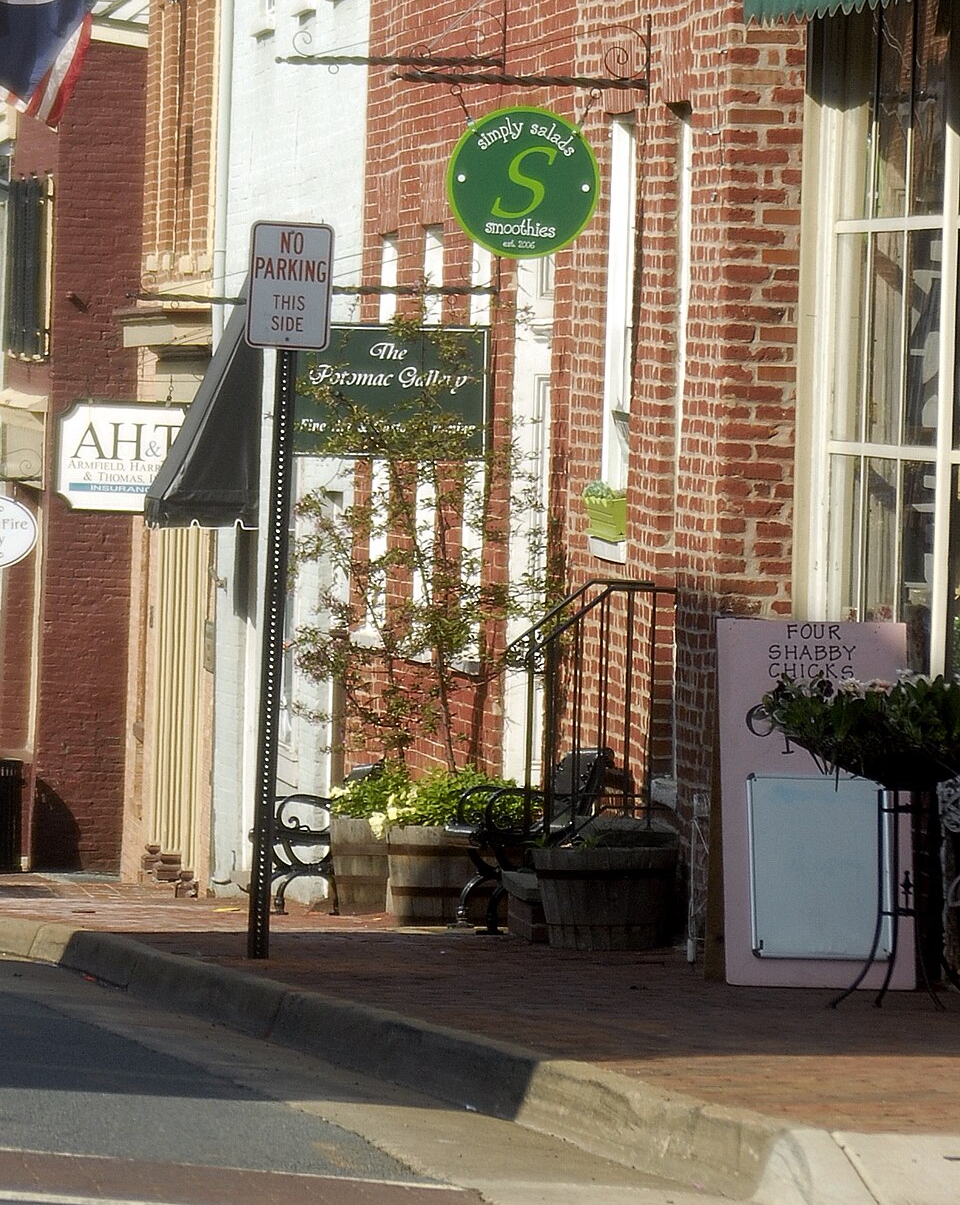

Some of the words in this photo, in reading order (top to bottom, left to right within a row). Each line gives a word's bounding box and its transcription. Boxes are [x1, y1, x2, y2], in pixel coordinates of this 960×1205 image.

[477, 117, 524, 150] simply
[530, 123, 575, 157] salads
[490, 146, 558, 219] S
[484, 218, 556, 238] smoothies
[280, 231, 304, 255] NO
[517, 240, 536, 249] 2006
[254, 256, 327, 283] PARKING
[272, 294, 306, 311] THIS
[271, 315, 304, 332] SIDE
[369, 342, 408, 360] The
[309, 364, 394, 387] Potomac
[67, 460, 126, 472] ARMFIELD,
[130, 461, 162, 472] HARR
[83, 472, 93, 482] &
[98, 472, 145, 484] THOMAS,
[2, 518, 29, 530] Fire
[786, 623, 842, 640] FOUR
[768, 644, 857, 661] SHABBY
[768, 662, 855, 680] CHICKS
